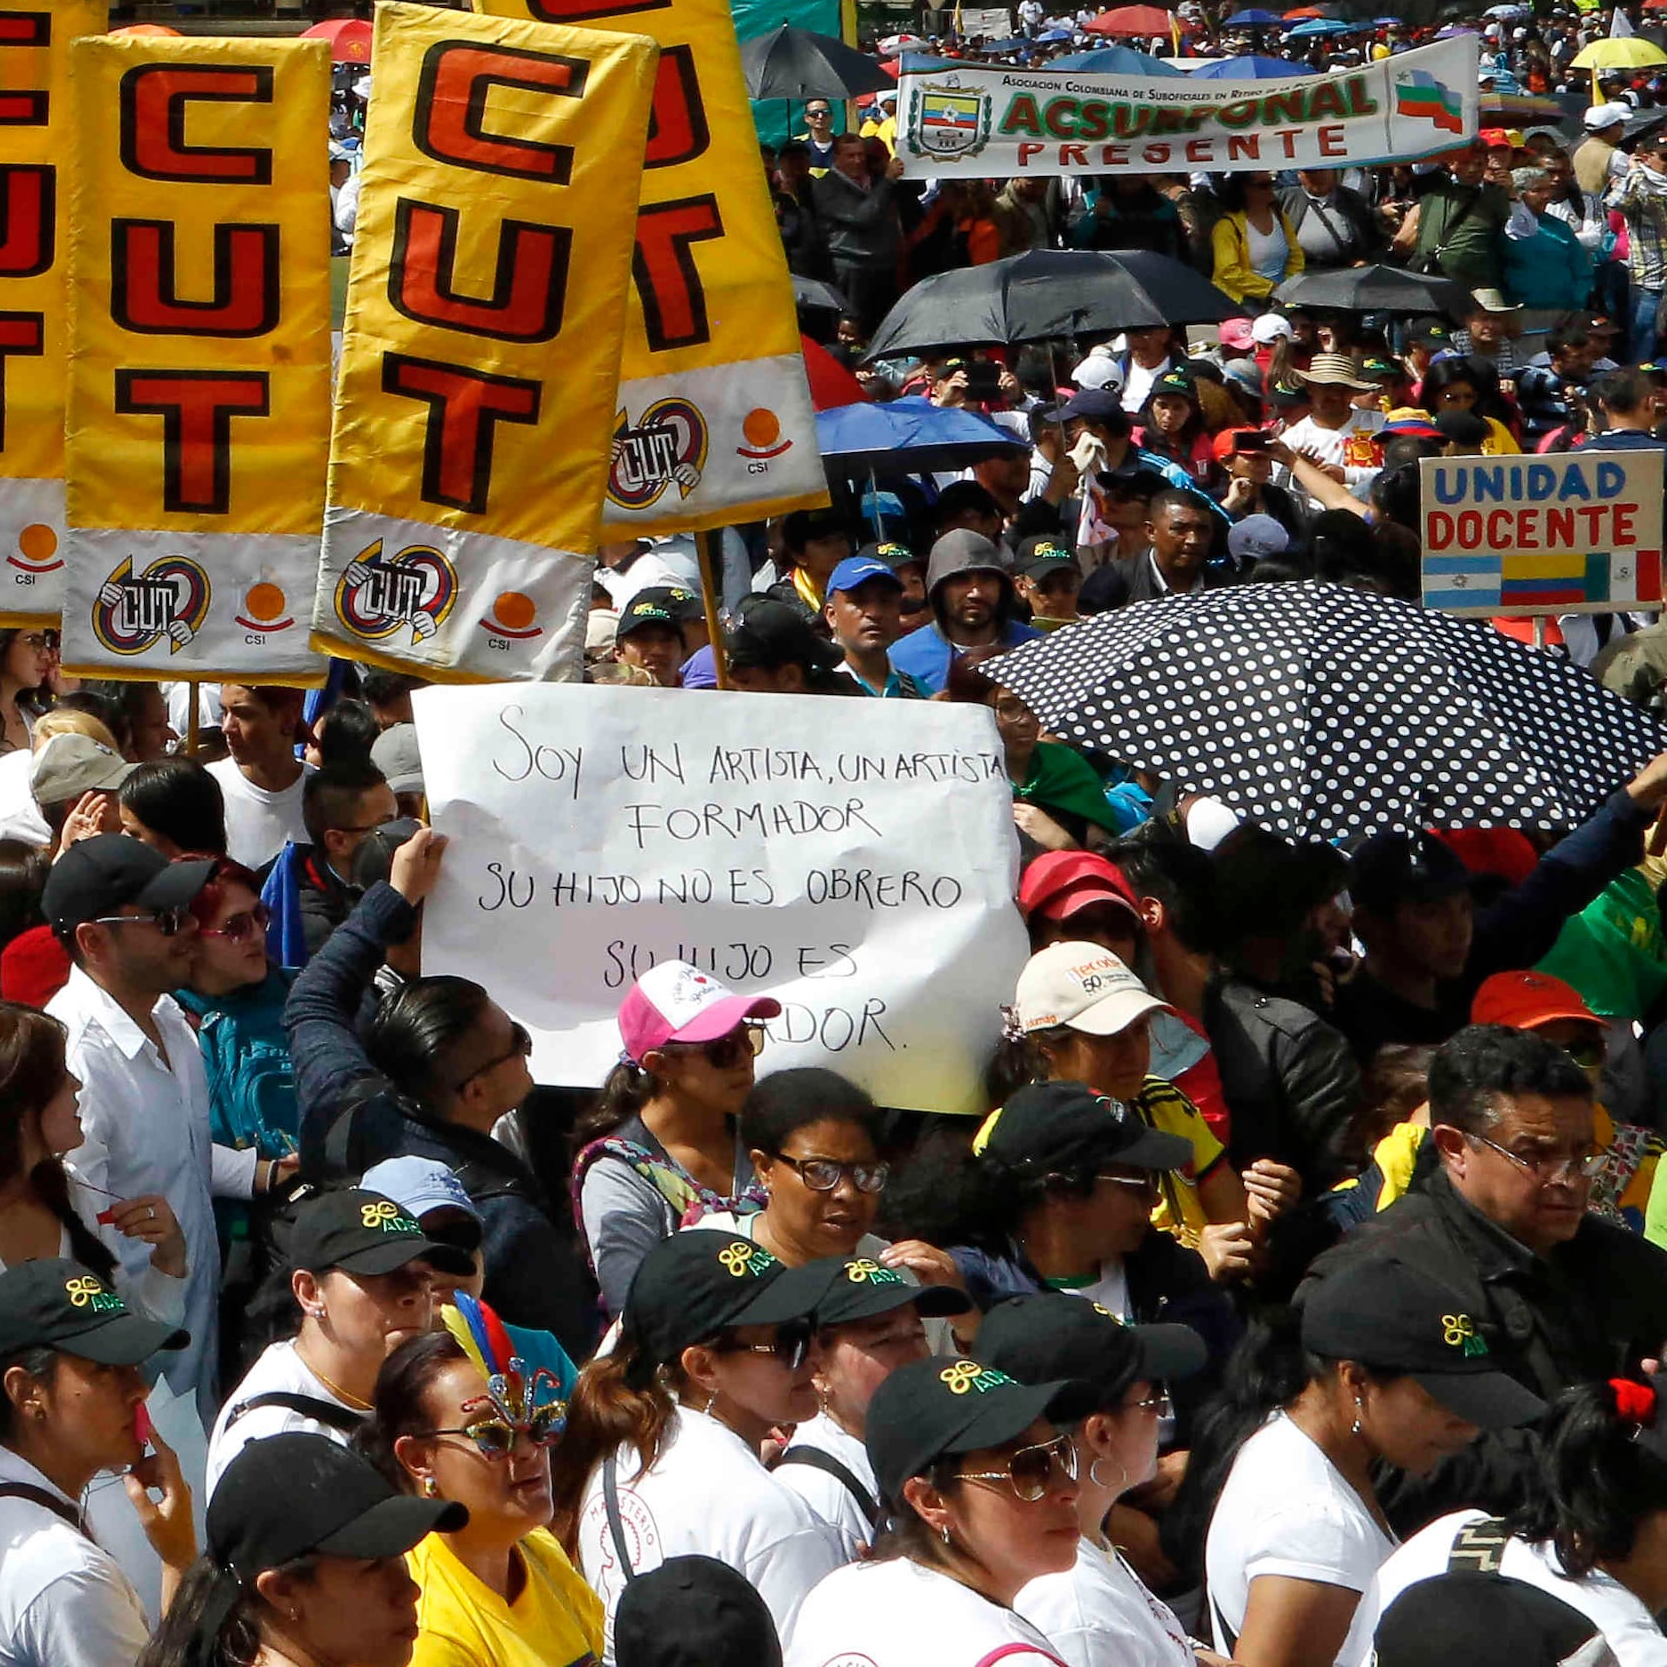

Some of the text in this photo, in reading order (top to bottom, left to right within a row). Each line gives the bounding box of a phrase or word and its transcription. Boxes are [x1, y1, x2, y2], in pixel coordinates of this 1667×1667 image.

[1018, 124, 1347, 166] PRESENTE
[110, 62, 279, 515] CUT
[381, 38, 591, 516] CUT
[624, 433, 675, 484] CUT
[747, 463, 769, 475] CSI
[1435, 462, 1626, 505] UNIDAD
[1427, 503, 1639, 551] DOCENTE
[15, 575, 36, 585] CSI
[365, 568, 421, 621] CUT
[121, 585, 175, 631] CUT
[244, 634, 266, 645] CSI
[487, 637, 510, 651] CSI
[492, 704, 584, 799] SOY
[621, 742, 685, 784] UN
[838, 752, 887, 782] UN
[625, 798, 883, 849] FORMADOR
[478, 861, 963, 911] SU HIJO NO ES OBRERO
[604, 940, 654, 988] SU
[798, 943, 858, 979] ES
[1082, 974, 1101, 994] 50
[360, 1201, 399, 1228] 80
[718, 1241, 752, 1277] 80
[65, 1275, 102, 1307] 80
[940, 1360, 983, 1394] 80
[590, 1496, 655, 1546] MASTERIO
